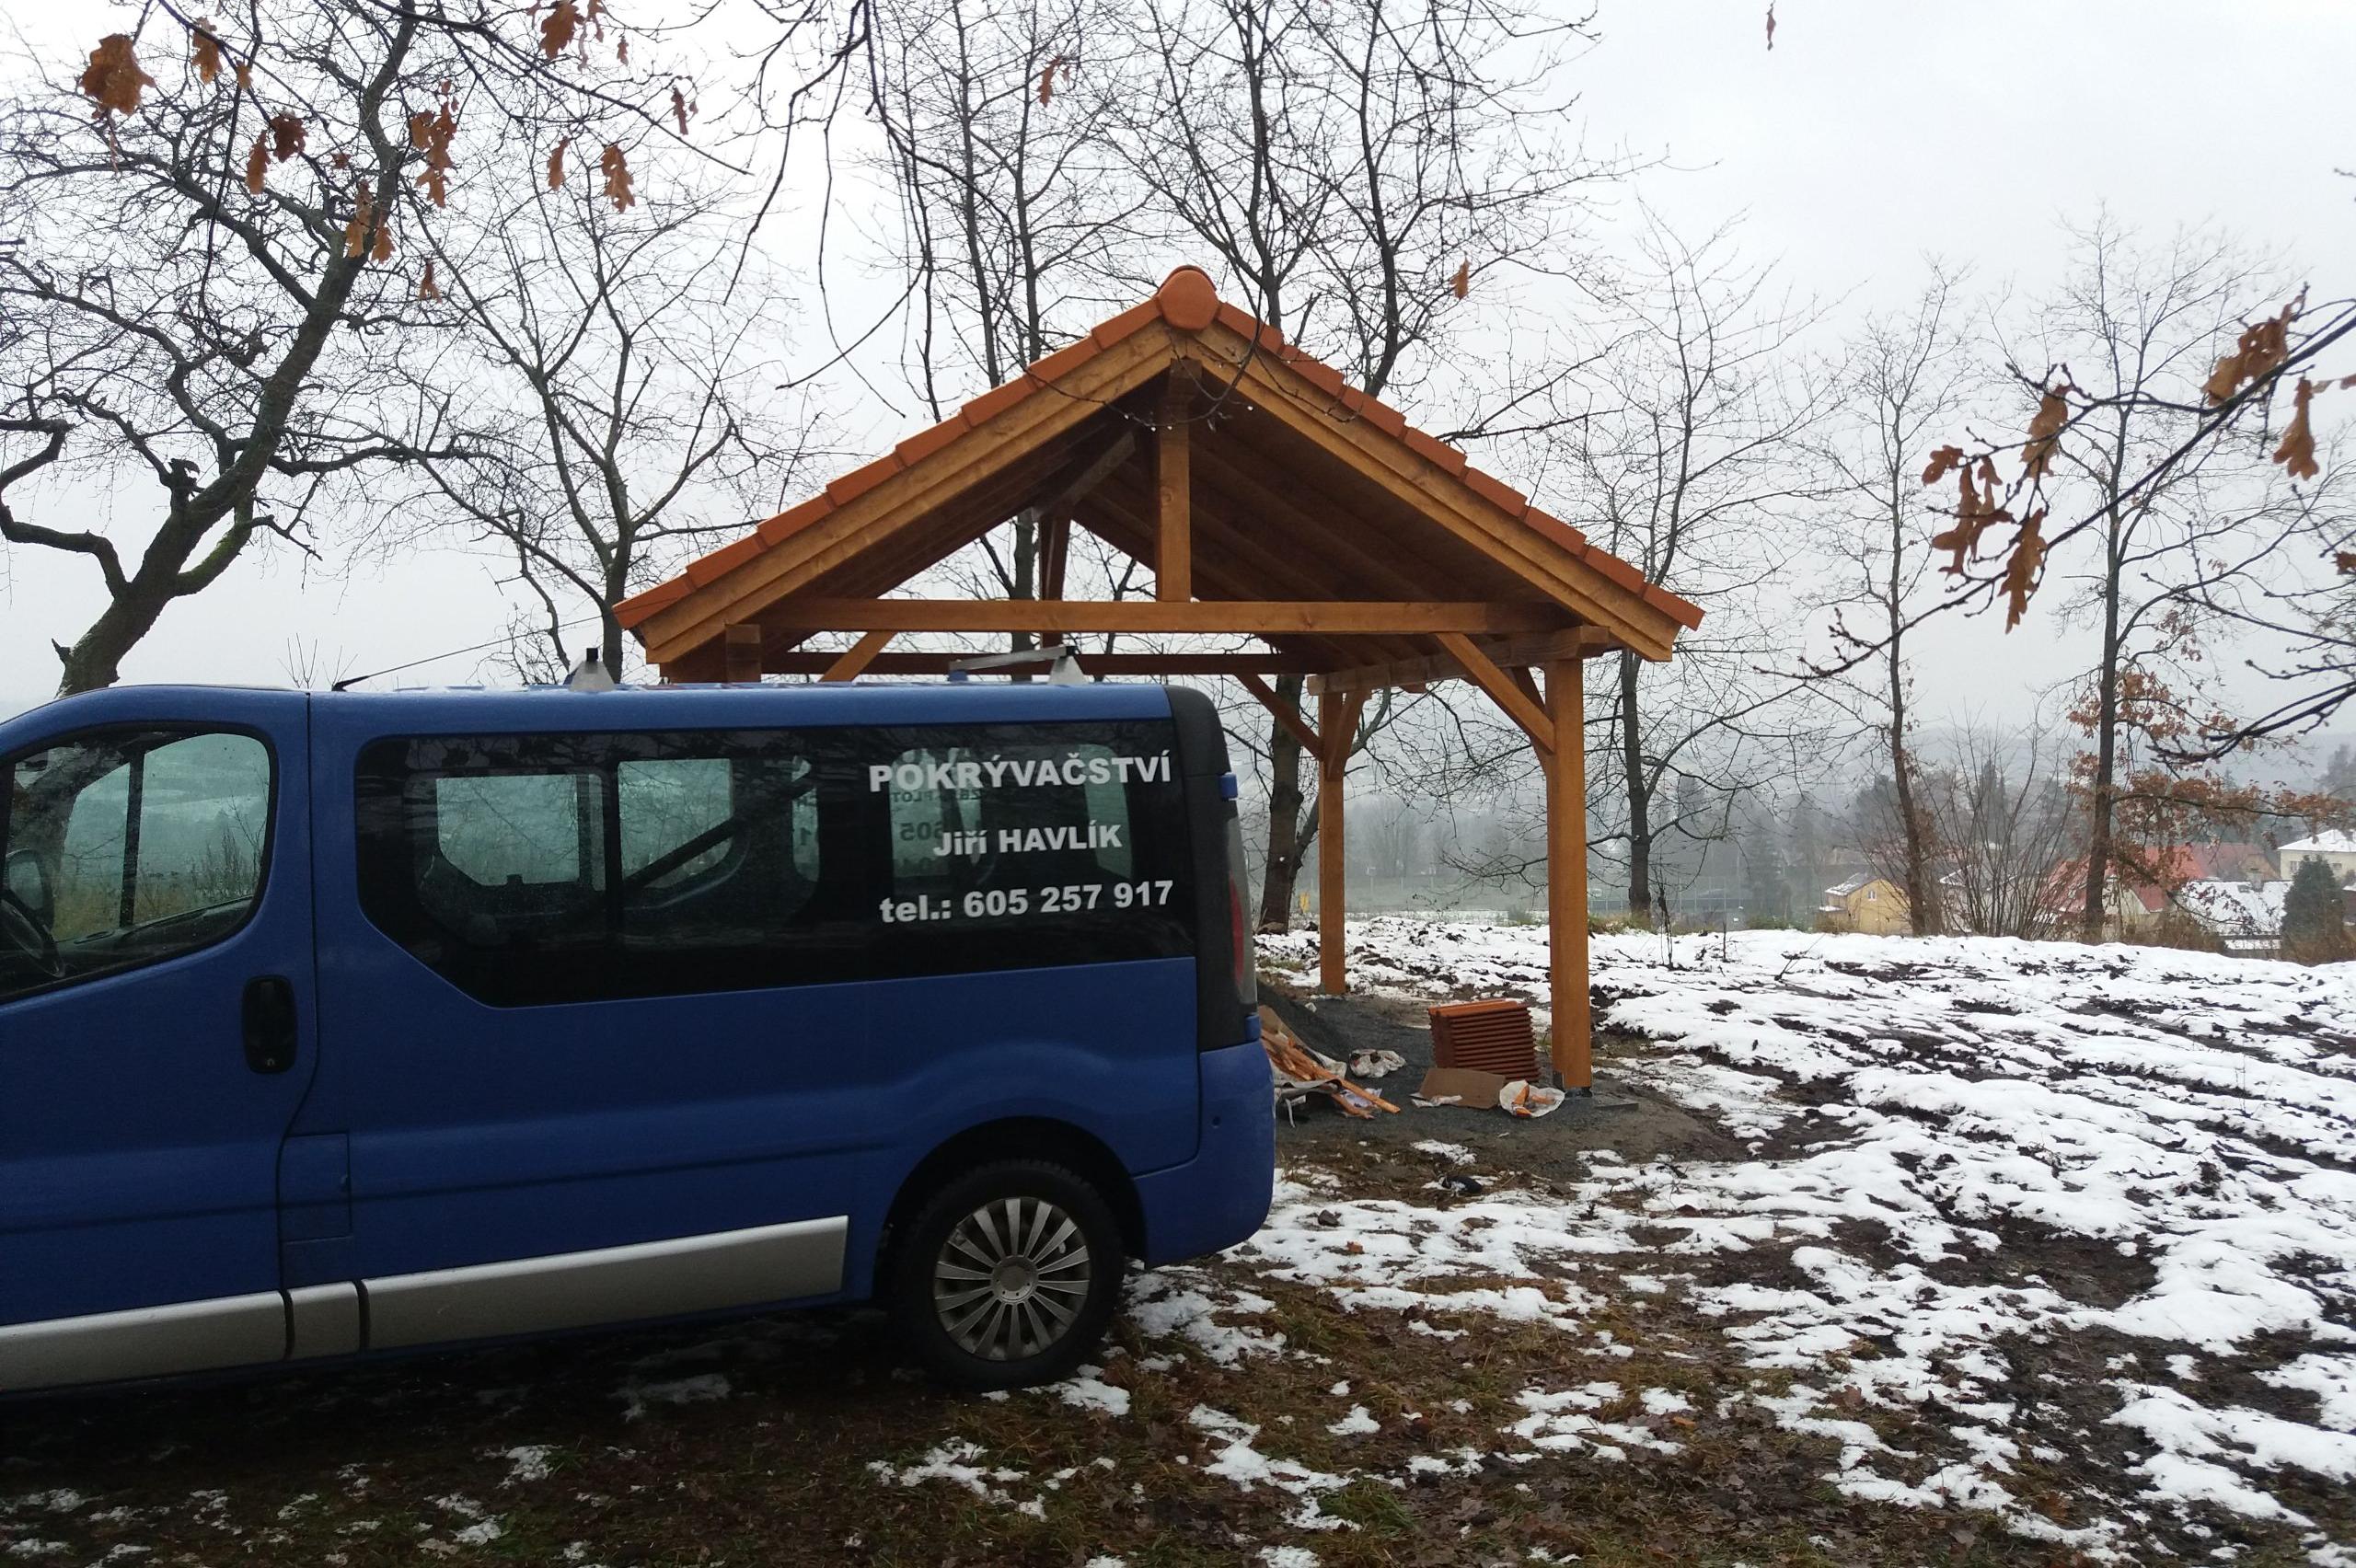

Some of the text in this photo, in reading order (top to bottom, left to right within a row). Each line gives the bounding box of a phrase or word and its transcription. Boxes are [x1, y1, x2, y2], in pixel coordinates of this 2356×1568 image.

[869, 750, 1171, 792] POKRÝVAČSTVÍ
[933, 819, 1122, 856] Jiří HAVLÍK
[879, 880, 1173, 923] tel.: 605 257 917
